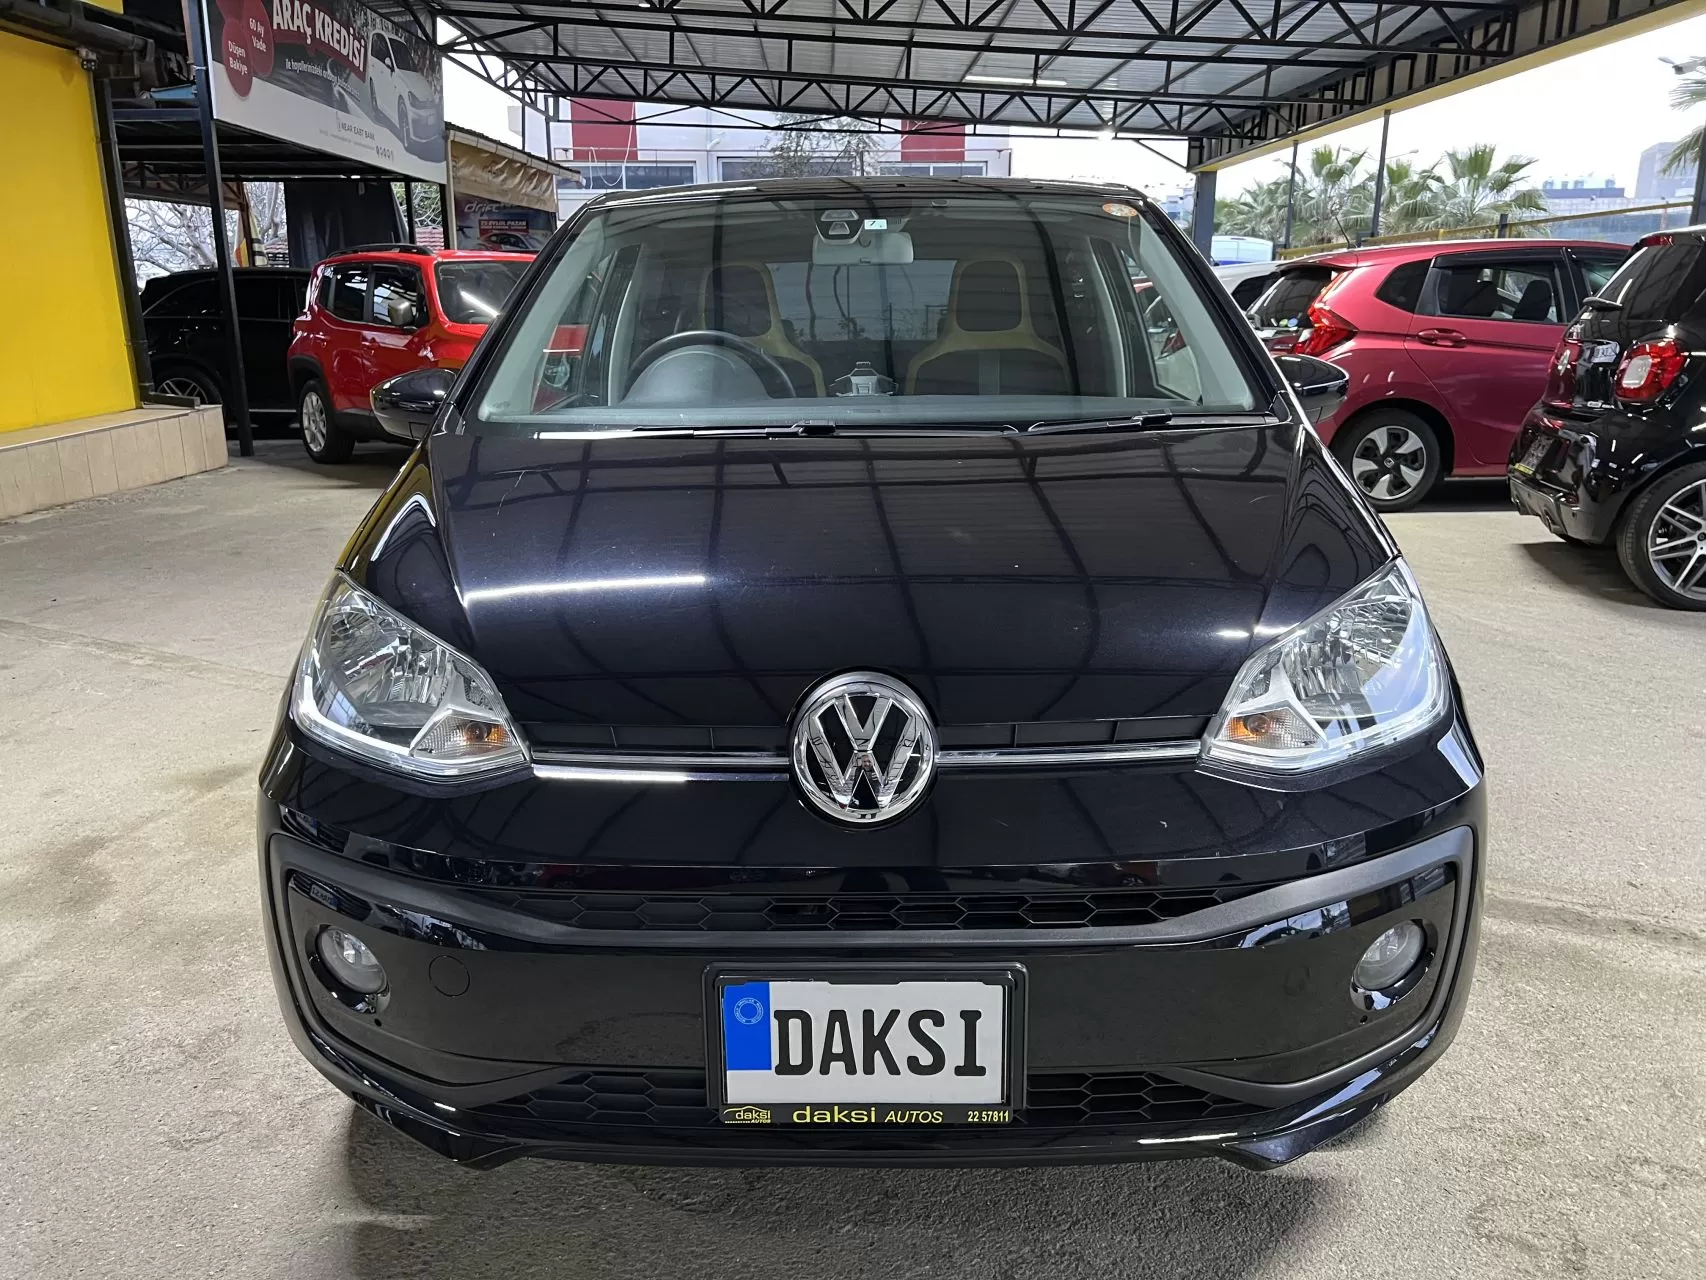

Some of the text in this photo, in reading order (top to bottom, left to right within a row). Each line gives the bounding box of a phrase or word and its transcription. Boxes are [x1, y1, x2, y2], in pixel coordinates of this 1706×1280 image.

[249, 18, 265, 37] 60 Ay
[272, 0, 366, 72] ARAÇ KREDİSİ
[228, 40, 246, 58] Düşen
[251, 36, 267, 52] Vade
[229, 58, 248, 75] Bakiye
[773, 1008, 987, 1077] DAKSI
[735, 1109, 771, 1120] daksi
[792, 1105, 944, 1123] daksi AUTOS
[967, 1110, 1010, 1122] 22 57811
